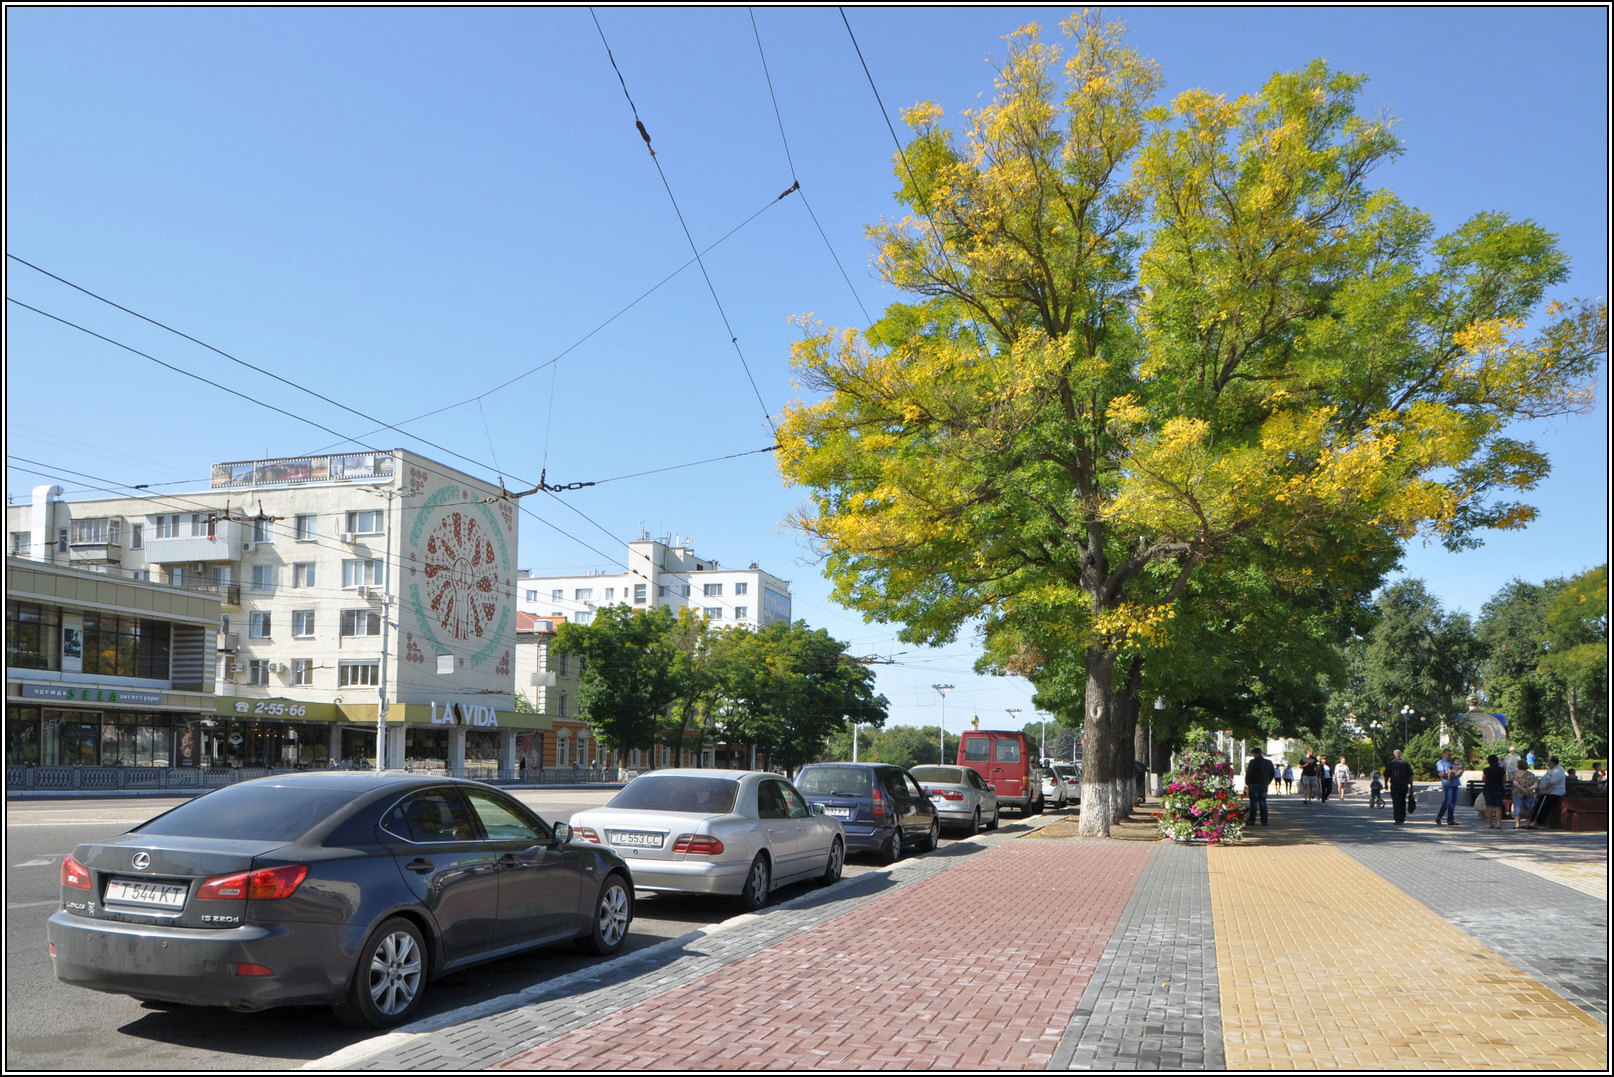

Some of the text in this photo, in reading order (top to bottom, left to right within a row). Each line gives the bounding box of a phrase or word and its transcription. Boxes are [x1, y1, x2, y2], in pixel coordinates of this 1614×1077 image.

[34, 688, 67, 697] одежда
[67, 688, 118, 702] SELA
[119, 693, 160, 702] аксессуары
[254, 701, 306, 717] 2-55-66
[431, 701, 499, 728] LA VIDA
[132, 883, 157, 902] 544
